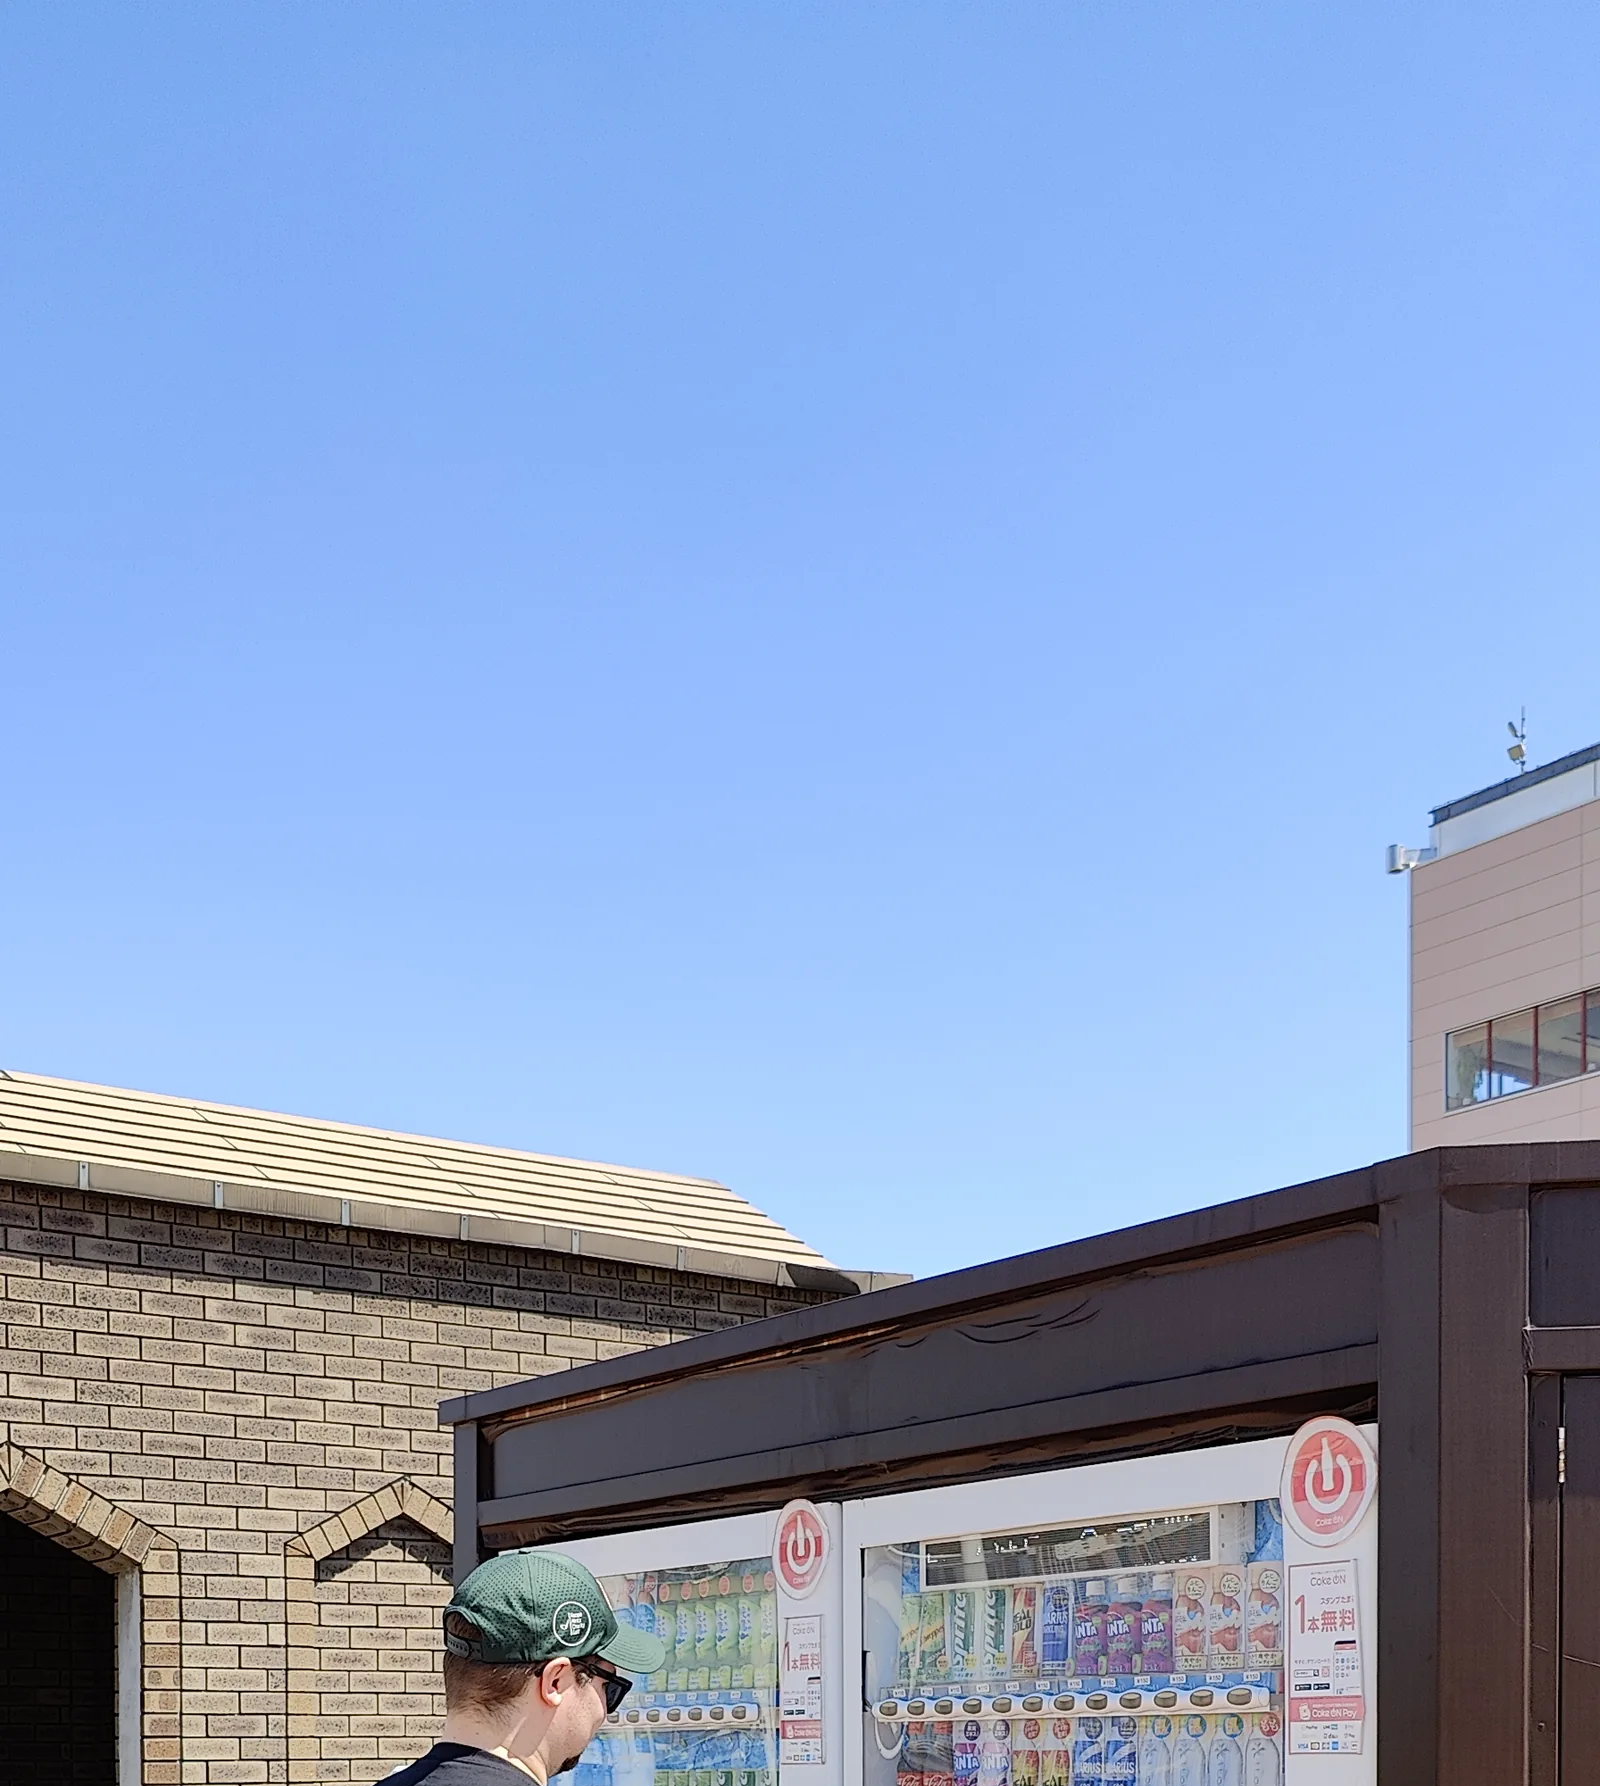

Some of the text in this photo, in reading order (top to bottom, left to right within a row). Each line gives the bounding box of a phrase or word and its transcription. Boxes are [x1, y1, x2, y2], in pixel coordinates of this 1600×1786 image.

[1310, 1574, 1346, 1586] Coke ON
[1320, 1596, 1354, 1605] スタンプたま
[1312, 1708, 1358, 1719] Coke ON Pay
